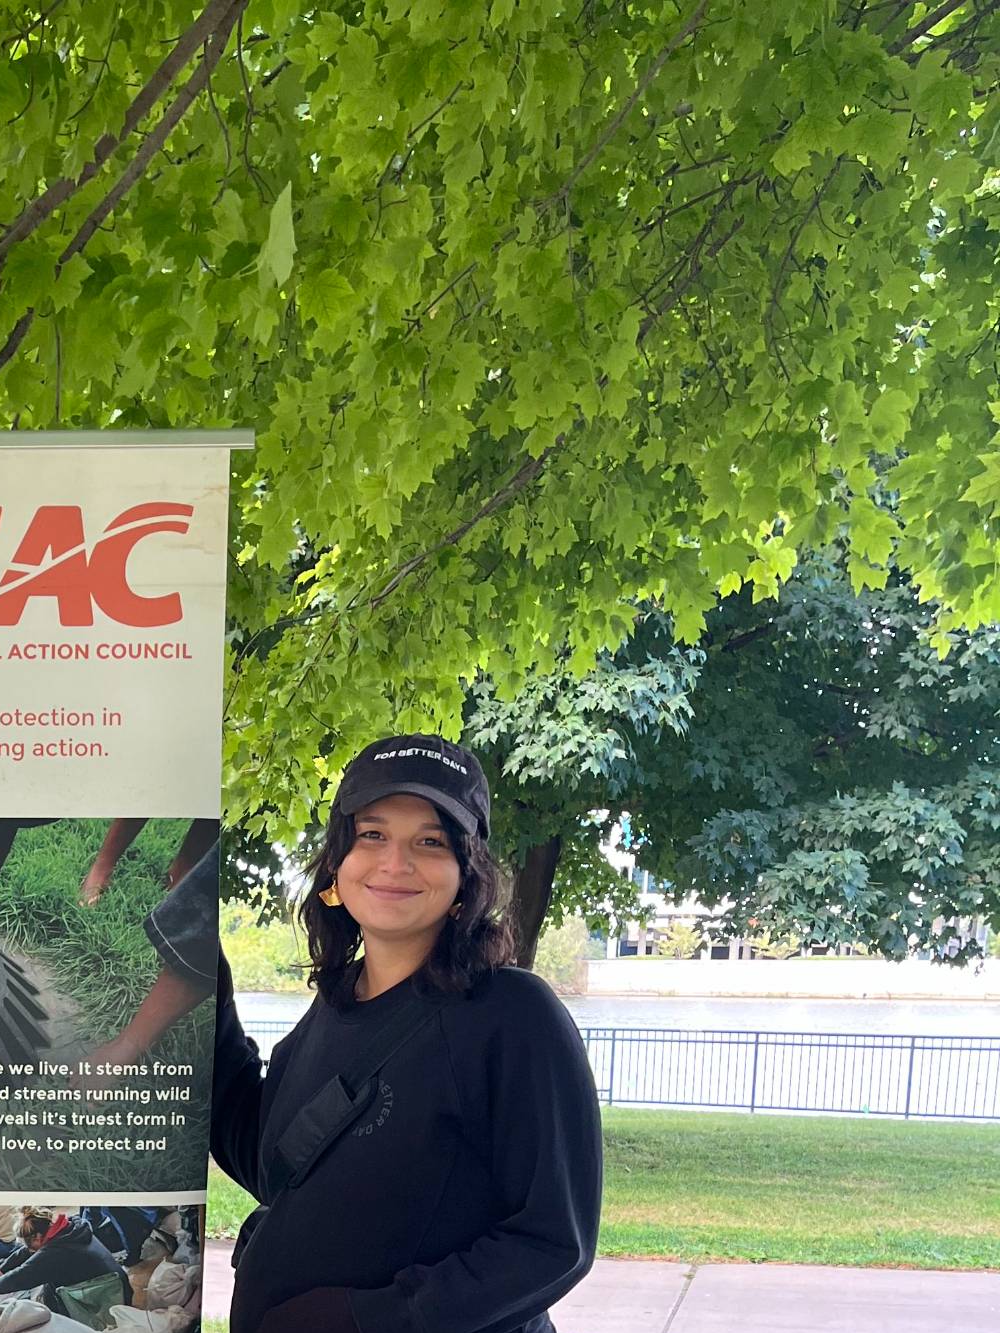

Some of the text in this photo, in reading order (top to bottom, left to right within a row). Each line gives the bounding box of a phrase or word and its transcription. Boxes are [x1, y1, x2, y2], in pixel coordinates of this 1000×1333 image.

[8, 643, 89, 660] ACTION
[96, 643, 193, 660] COUNCIL
[102, 708, 122, 726] in
[31, 738, 109, 757] action.
[374, 748, 468, 775] FOR BETTER DAYS
[8, 1064, 33, 1075] we
[39, 1060, 73, 1075] live.
[79, 1062, 91, 1075] It
[96, 1062, 148, 1076] stems
[152, 1061, 192, 1076] from
[42, 1110, 66, 1125] it's
[71, 1112, 122, 1126] truest
[126, 1111, 166, 1126] form
[171, 1111, 185, 1125] in
[1, 1135, 41, 1151] love,
[45, 1136, 64, 1150] to
[68, 1137, 131, 1153] protect
[135, 1136, 166, 1150] and
